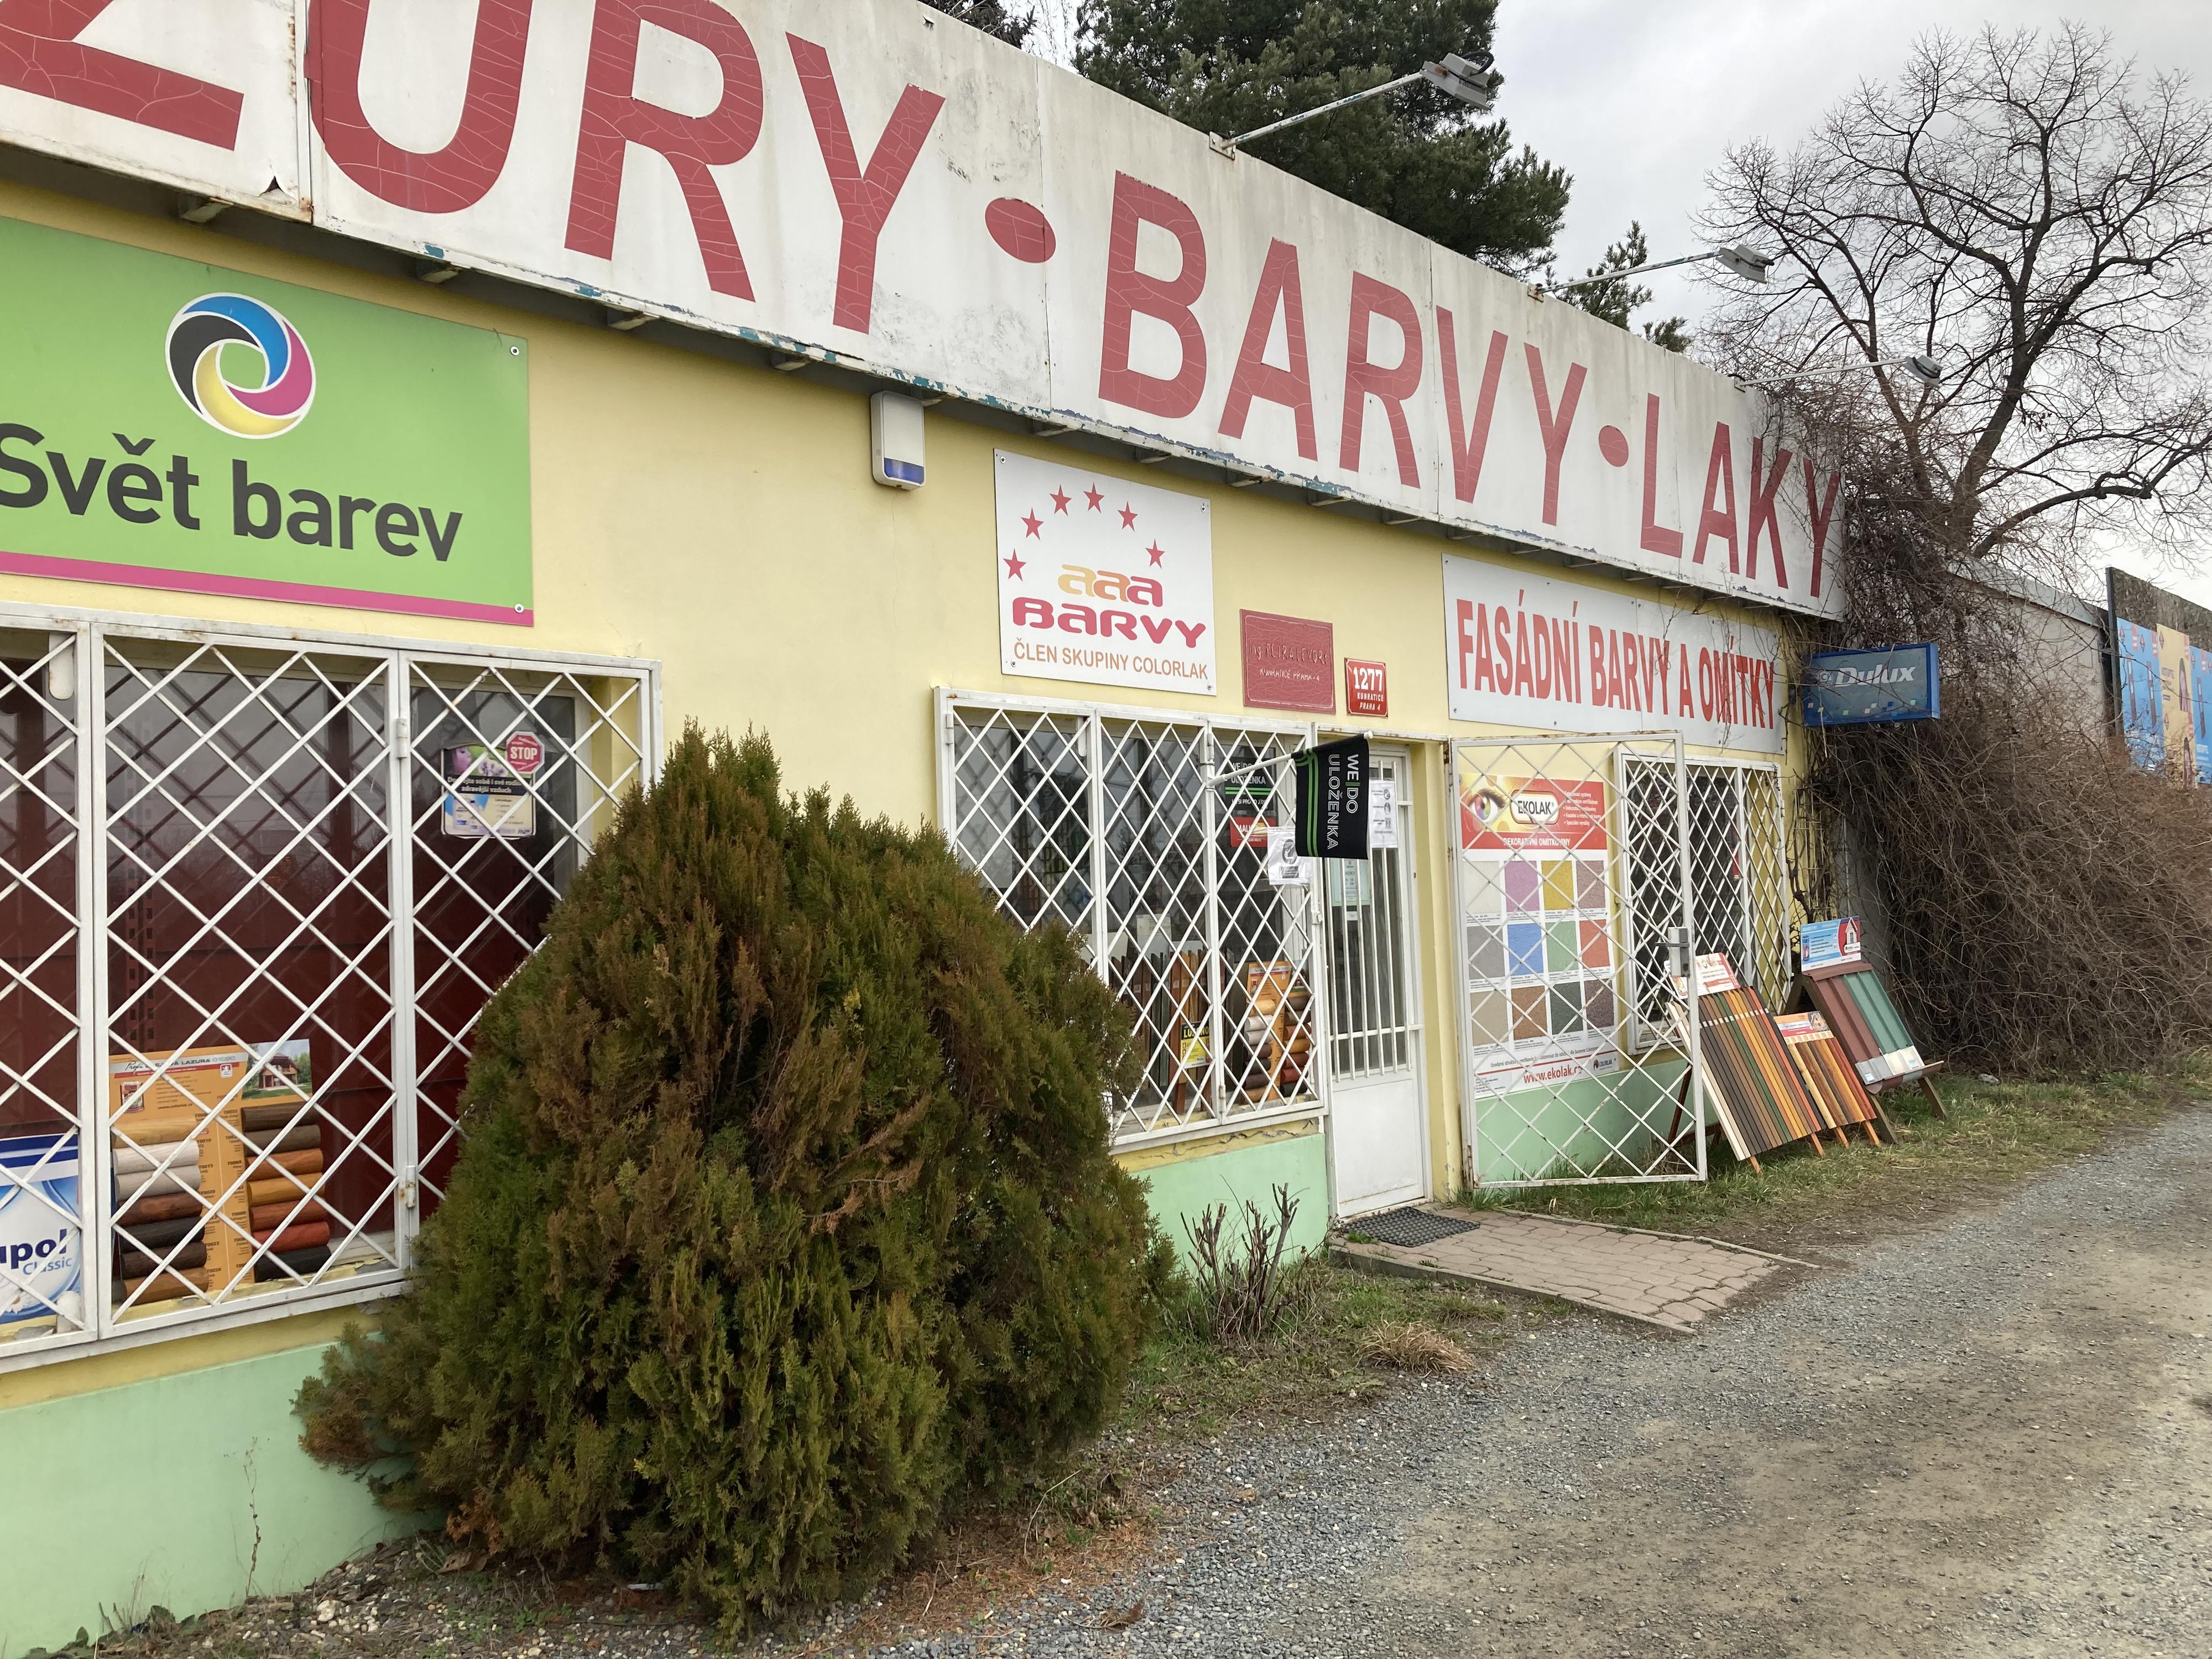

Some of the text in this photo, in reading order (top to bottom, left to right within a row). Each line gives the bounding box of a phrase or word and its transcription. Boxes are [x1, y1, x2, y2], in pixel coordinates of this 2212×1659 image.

[1098, 169, 1588, 526] BARVY
[1640, 392, 1840, 598] LAKY
[0, 422, 463, 562] Svět barev
[1057, 564, 1163, 607] aaa
[1014, 637, 1208, 680] ČLEN SKUPINY COLORLAK
[1456, 588, 1774, 730] FASÁDNÍ BARVY A OMÍTKY
[1353, 666, 1383, 692] 1277
[1835, 664, 1916, 688] Dulux
[1357, 691, 1384, 702] KUNRATICE
[1359, 701, 1375, 711] PRAHA
[510, 747, 538, 760] STOP
[1326, 754, 1343, 850] ULOŽENKA
[1517, 800, 1552, 815] EKOLAK
